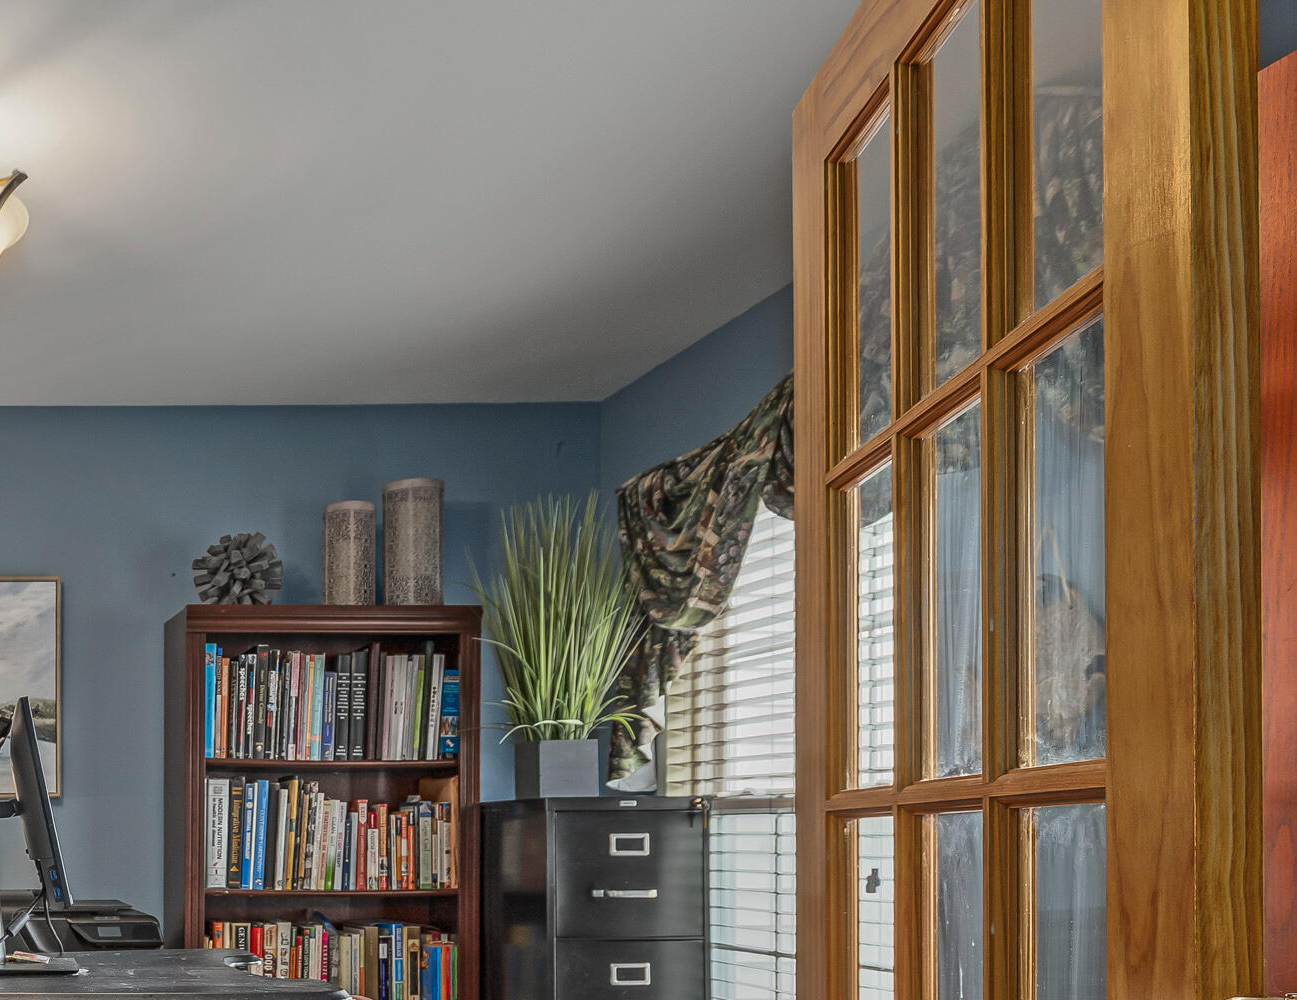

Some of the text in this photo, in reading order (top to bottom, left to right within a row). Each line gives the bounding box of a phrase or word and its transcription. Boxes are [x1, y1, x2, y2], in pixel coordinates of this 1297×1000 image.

[246, 704, 254, 735] speeches
[231, 799, 242, 864] Integrative Medicine
[264, 949, 273, 971] FOOD
